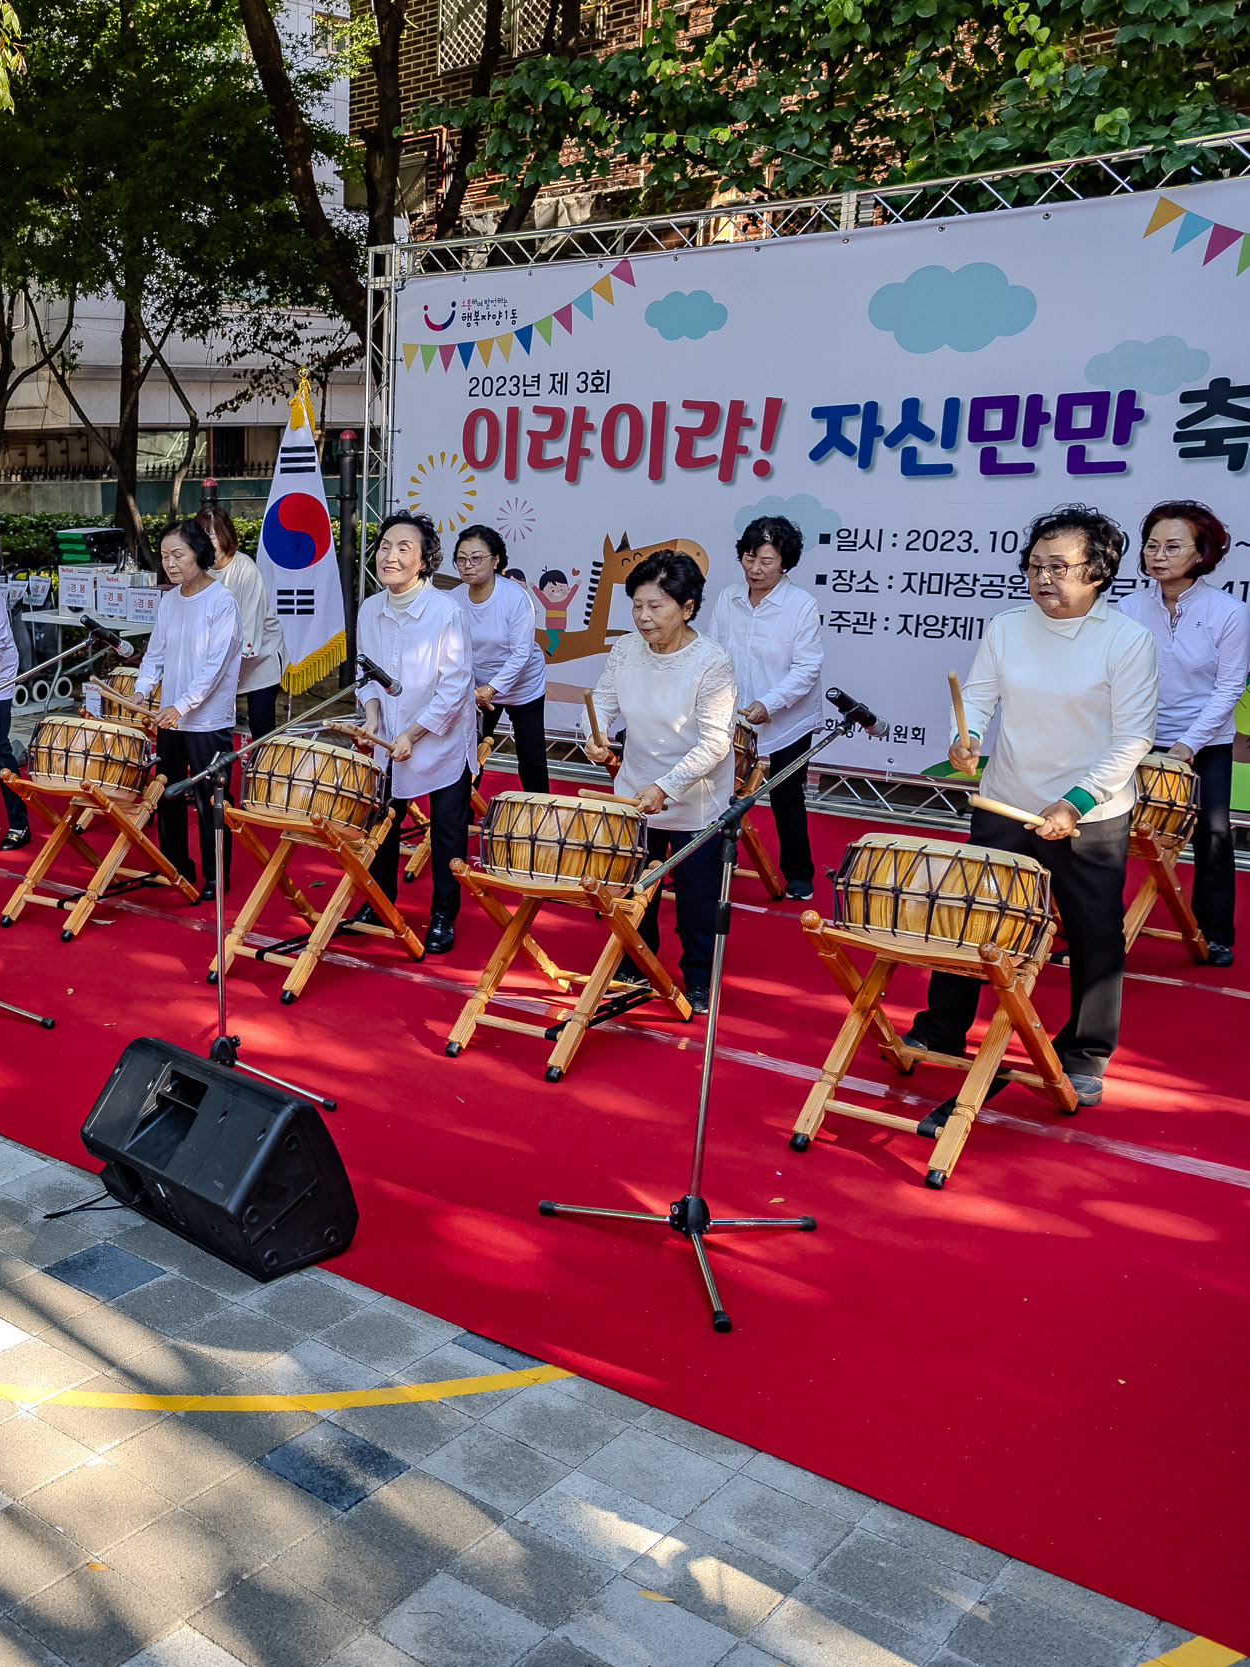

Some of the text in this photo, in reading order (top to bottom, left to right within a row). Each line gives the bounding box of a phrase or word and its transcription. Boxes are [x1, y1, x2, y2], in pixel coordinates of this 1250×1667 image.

[461, 308, 518, 328] 행복자양1동
[467, 369, 612, 398] 2023년 제 3회
[462, 396, 784, 484] 이랴이랴!
[807, 389, 1146, 477] 자신만만
[835, 527, 884, 553] 일시
[905, 528, 979, 554] 2023.
[831, 569, 879, 594] 장소
[828, 610, 878, 636] 주관
